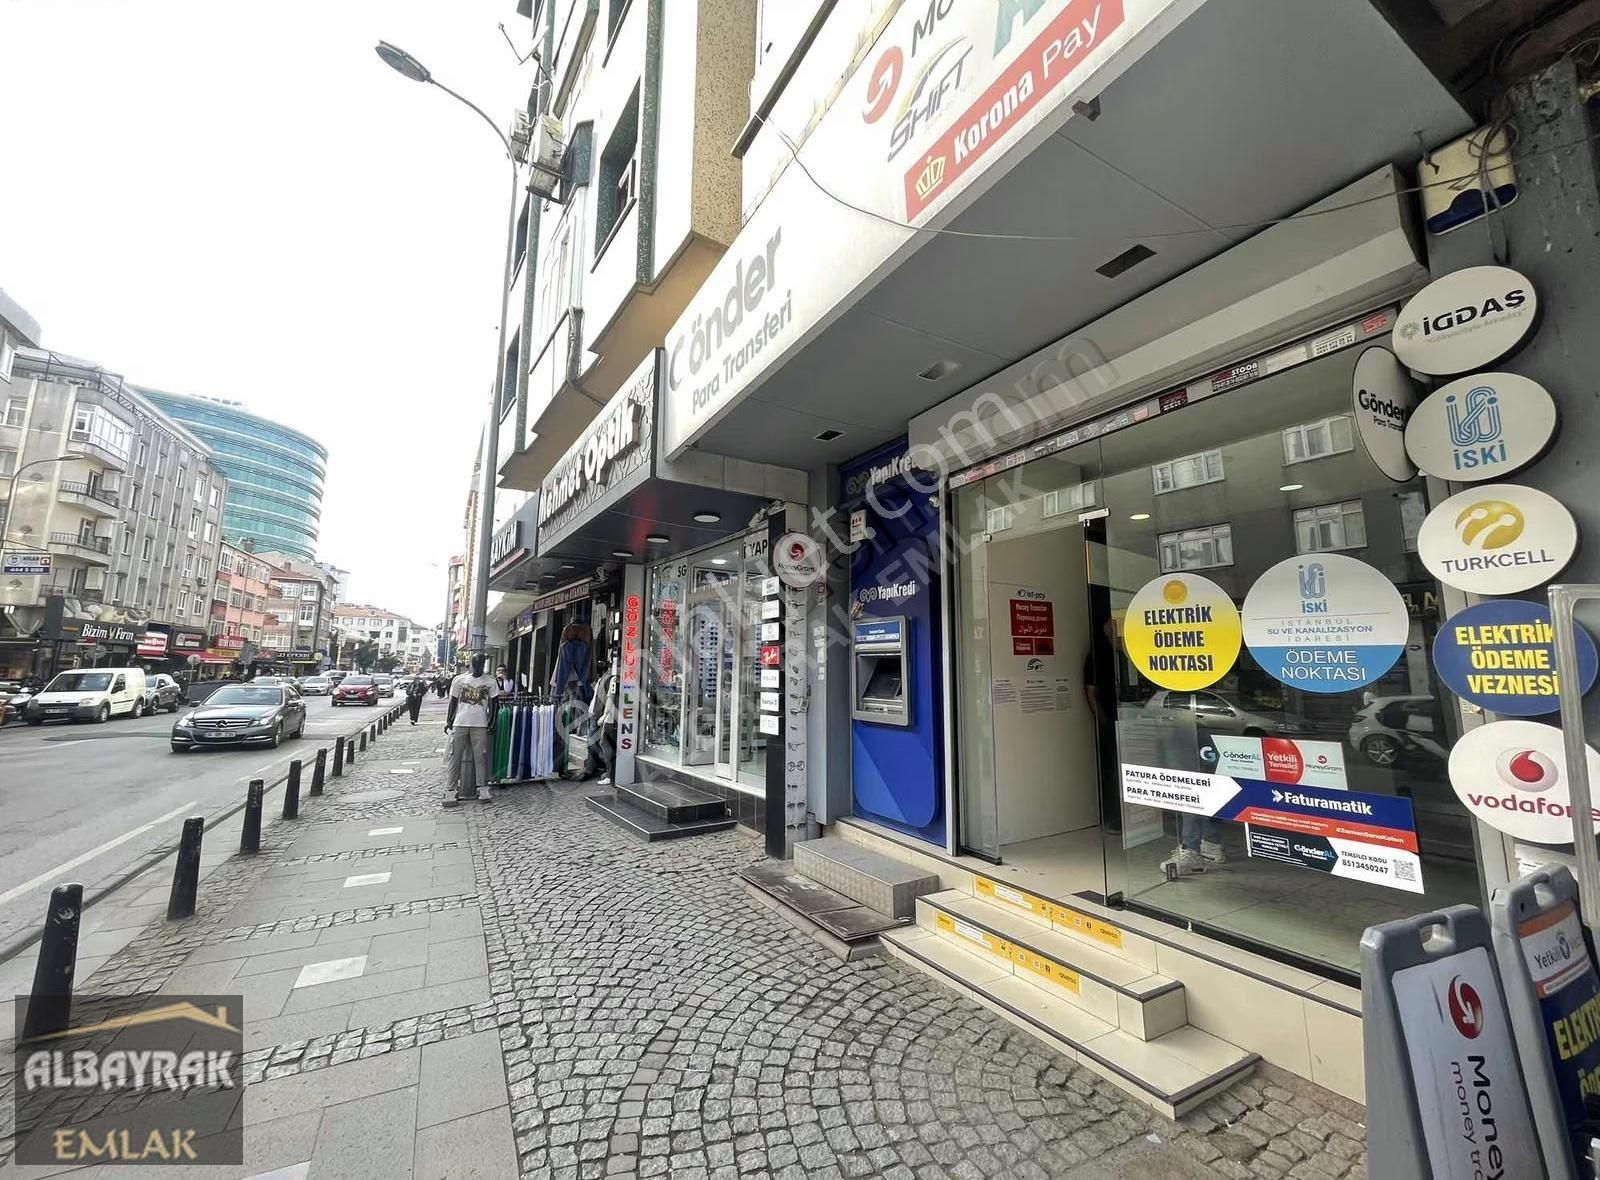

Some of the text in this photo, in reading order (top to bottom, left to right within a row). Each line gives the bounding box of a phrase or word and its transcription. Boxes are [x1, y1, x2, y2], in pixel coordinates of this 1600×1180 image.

[953, 71, 1034, 165] Korona
[1042, 3, 1101, 80] Pay
[888, 44, 974, 162] SHIFT
[692, 288, 792, 415] Para Transferi
[1452, 440, 1507, 470] İSKİ
[870, 456, 918, 486] YapıKre
[1441, 549, 1555, 573] TURKCELL
[877, 581, 916, 600] YapıKredi
[1144, 605, 1213, 627] ELEKTRİK
[1301, 599, 1328, 614] İSKİ
[81, 623, 107, 639] Bizim
[1154, 630, 1205, 648] ÖDEME
[1149, 655, 1215, 672] NOKTASI
[1285, 649, 1358, 664] ÖDEME
[1471, 646, 1550, 669] ÖDEME
[1281, 666, 1366, 681] NOKTASI
[1466, 671, 1561, 695] VEZNESİ
[620, 693, 634, 750] LENS
[1267, 752, 1297, 763] Yetkili
[1125, 770, 1157, 780] FATURA
[1159, 772, 1211, 788] ÖDEMELERİ
[1127, 786, 1149, 796] PARA
[1150, 790, 1200, 804] TRANSFERİ
[1284, 791, 1373, 816] Faturamatik
[1467, 793, 1600, 821] vodafoe
[1451, 1062, 1477, 1144] money
